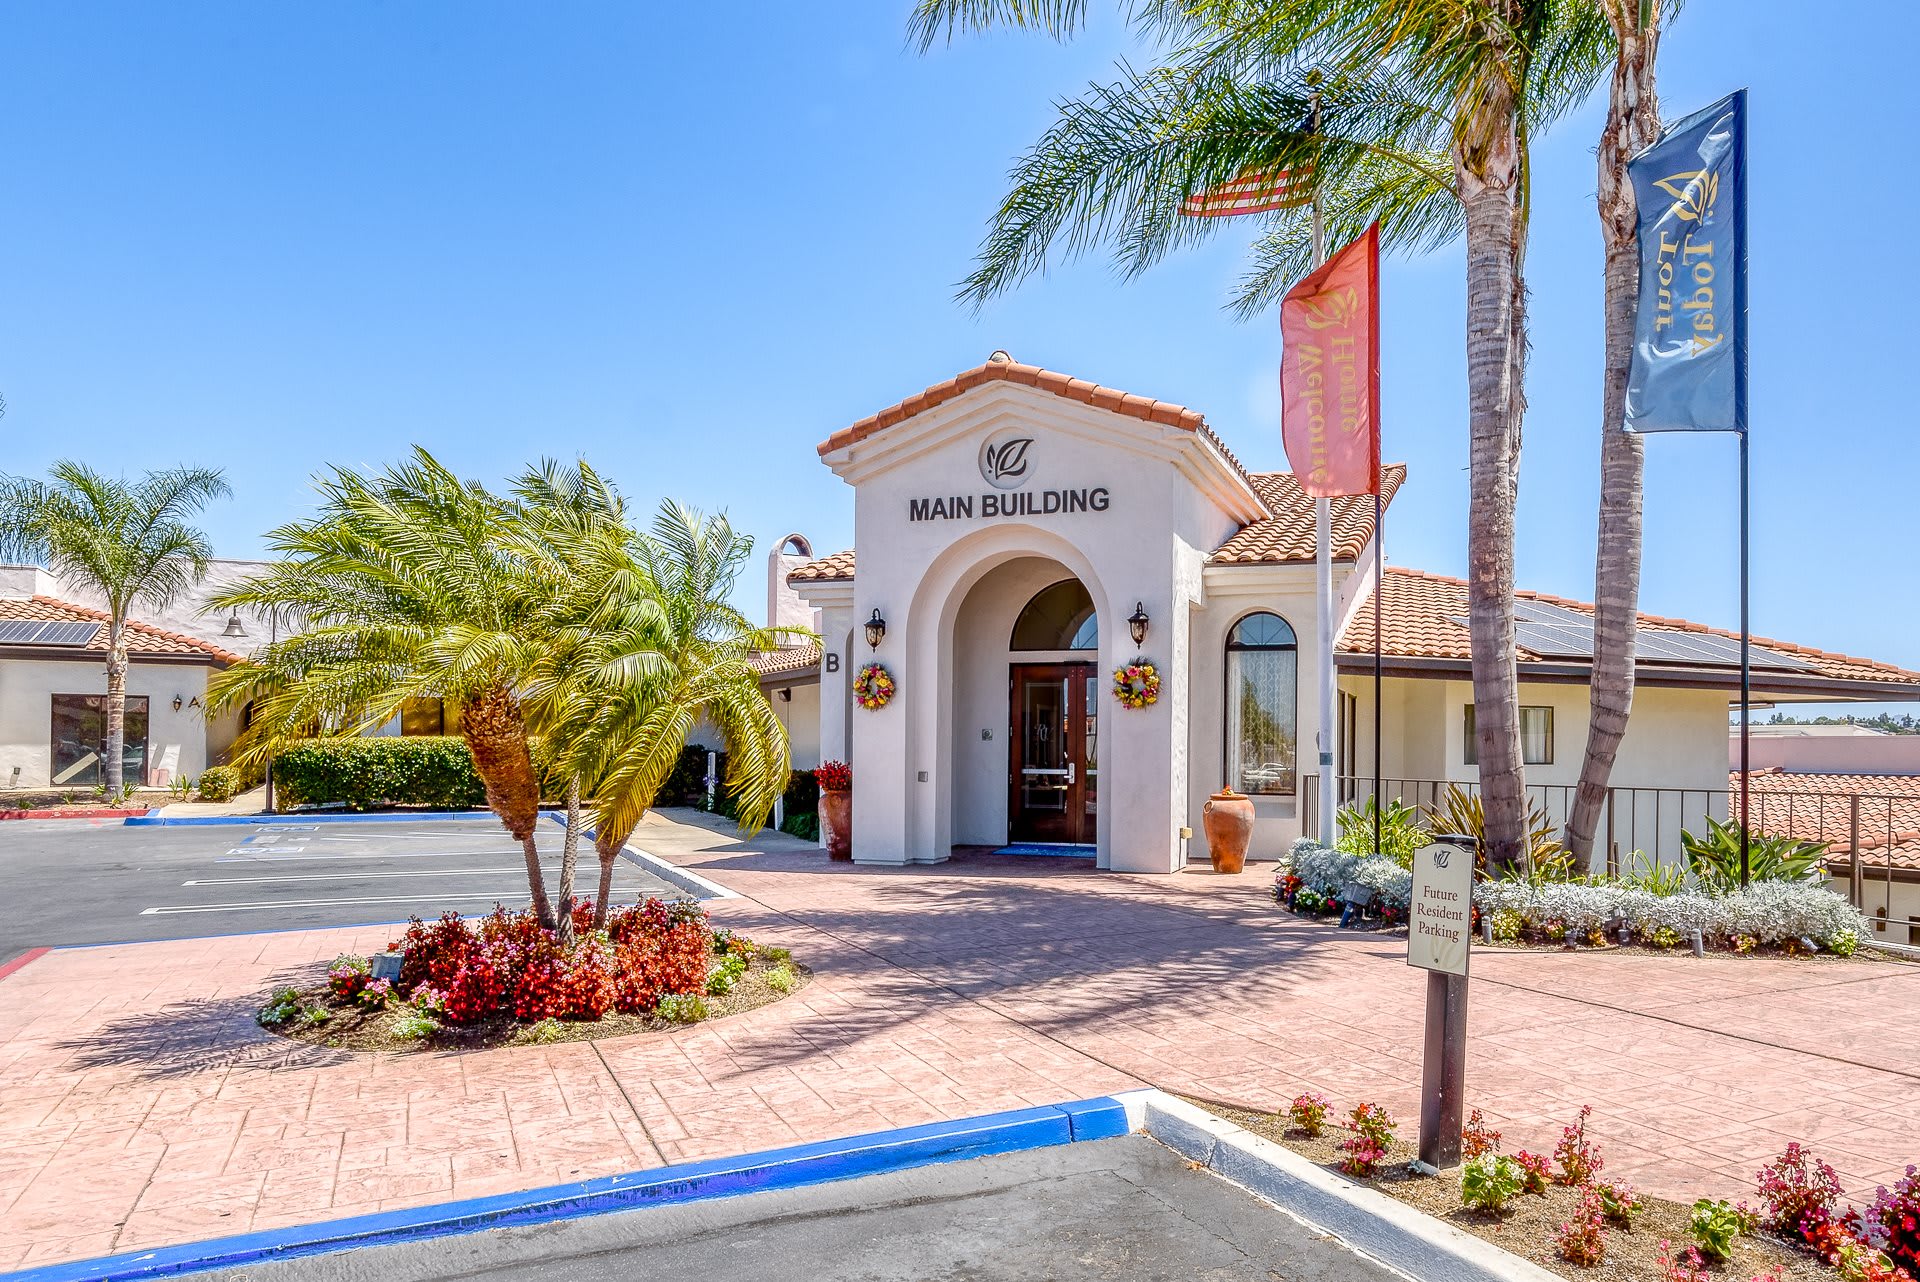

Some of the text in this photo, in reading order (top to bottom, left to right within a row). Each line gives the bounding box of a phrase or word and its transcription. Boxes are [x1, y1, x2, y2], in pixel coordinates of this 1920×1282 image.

[909, 487, 1110, 522] MAIN BUILDING
[826, 652, 840, 673] B
[187, 695, 201, 708] A
[1423, 885, 1458, 901] Future
[1416, 902, 1463, 921] Resident
[1418, 920, 1460, 943] Parking
